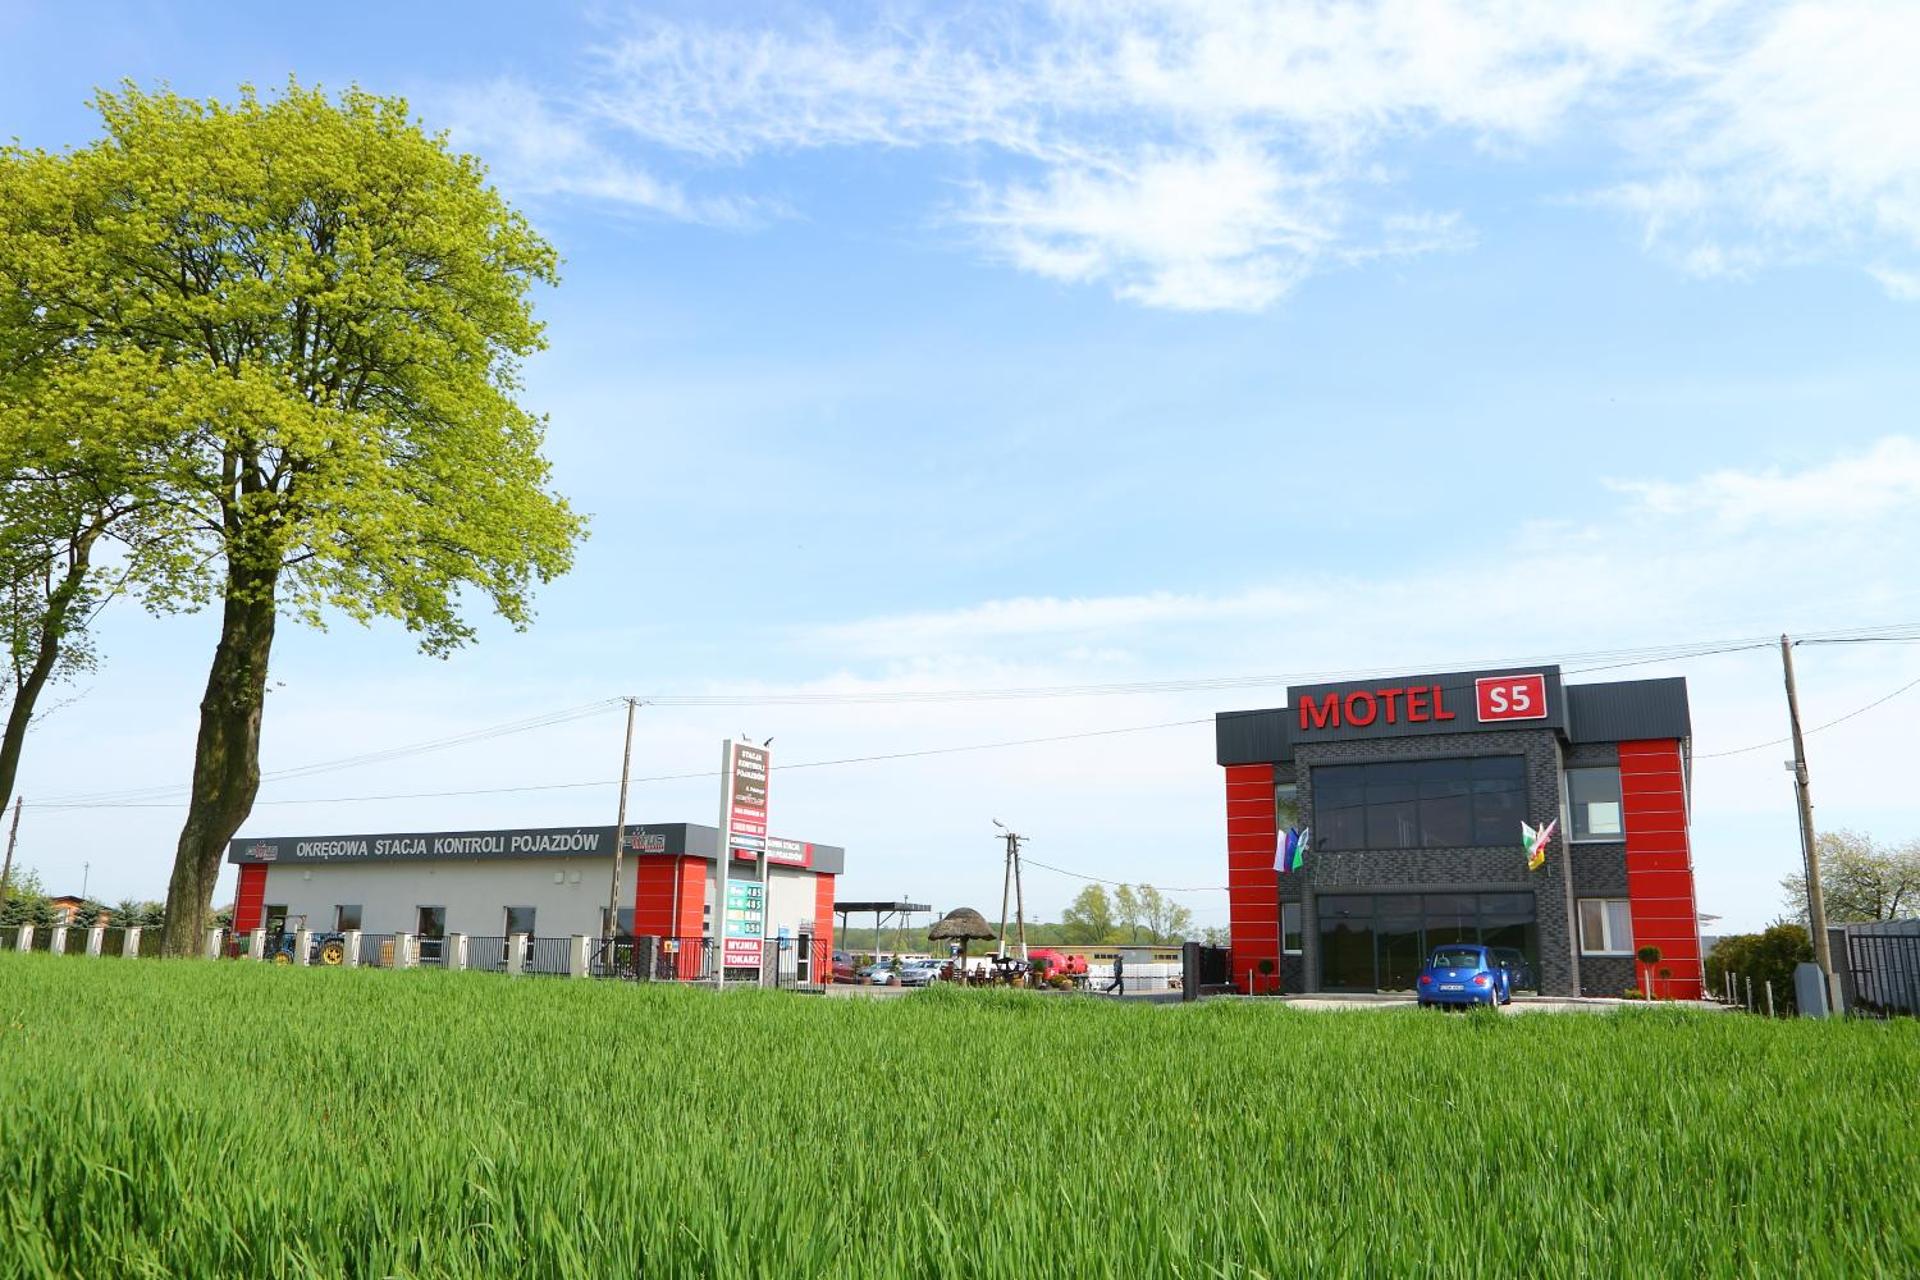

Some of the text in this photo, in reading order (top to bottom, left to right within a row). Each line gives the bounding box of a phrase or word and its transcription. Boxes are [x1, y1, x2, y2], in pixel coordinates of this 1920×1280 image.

[1299, 685, 1531, 731] MOTEL S5
[296, 841, 368, 860] OKRĘGOWA
[374, 838, 427, 855] STACJA
[433, 836, 504, 854] KONTROLI
[511, 829, 599, 852] POJAZDÓW
[726, 954, 760, 965] TOKARZ
